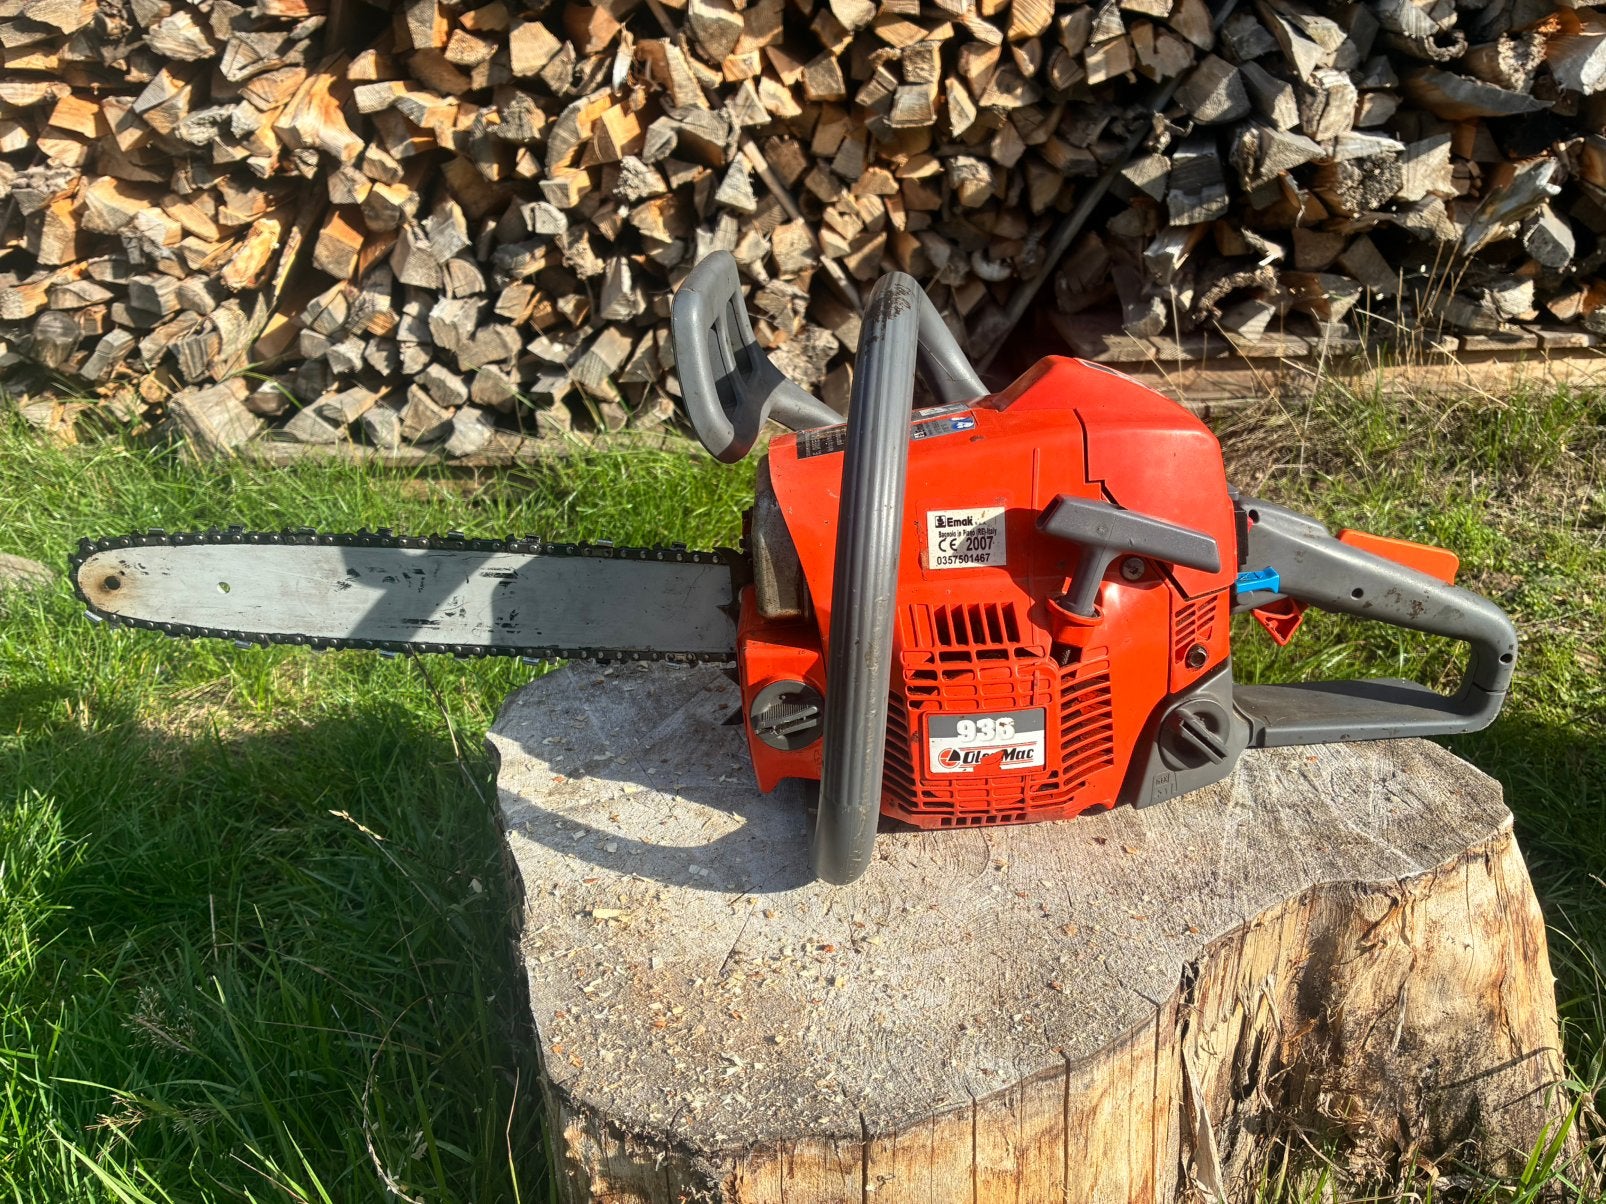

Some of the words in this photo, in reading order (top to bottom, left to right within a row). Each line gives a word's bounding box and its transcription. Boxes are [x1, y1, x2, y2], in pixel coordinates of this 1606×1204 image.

[947, 516, 973, 527] Emak
[966, 536, 993, 551] 2007
[936, 553, 991, 565] 0357501467
[956, 717, 1016, 743] 936
